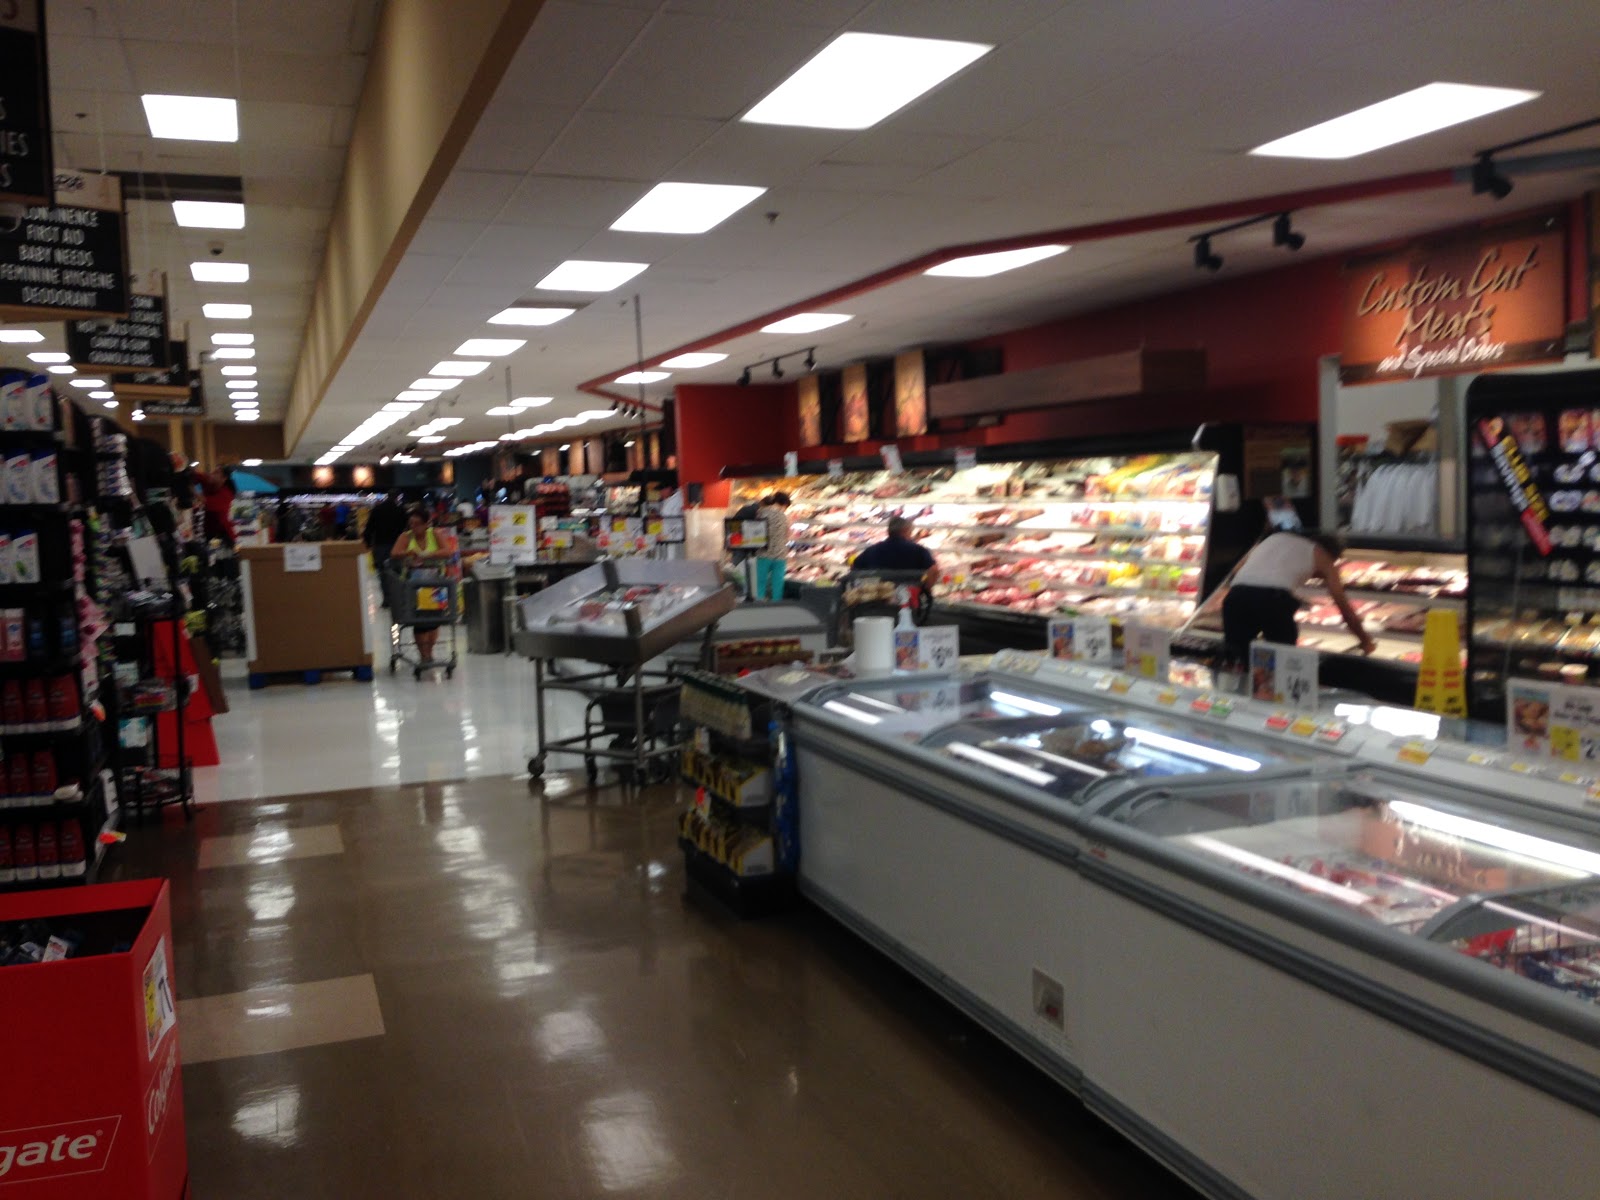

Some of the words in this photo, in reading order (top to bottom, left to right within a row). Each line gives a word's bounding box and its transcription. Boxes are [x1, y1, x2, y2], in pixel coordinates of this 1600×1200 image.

[26, 223, 60, 243] FIRST
[61, 227, 85, 246] AID
[18, 244, 52, 262] BABY
[53, 247, 94, 267] NEEDS
[0, 263, 61, 285] FEMININE
[62, 269, 115, 290] HYGIENE
[1357, 265, 1462, 317] Custom
[1467, 244, 1539, 296] Cut
[22, 285, 98, 308] DEODORANT
[1395, 295, 1496, 346] Meats
